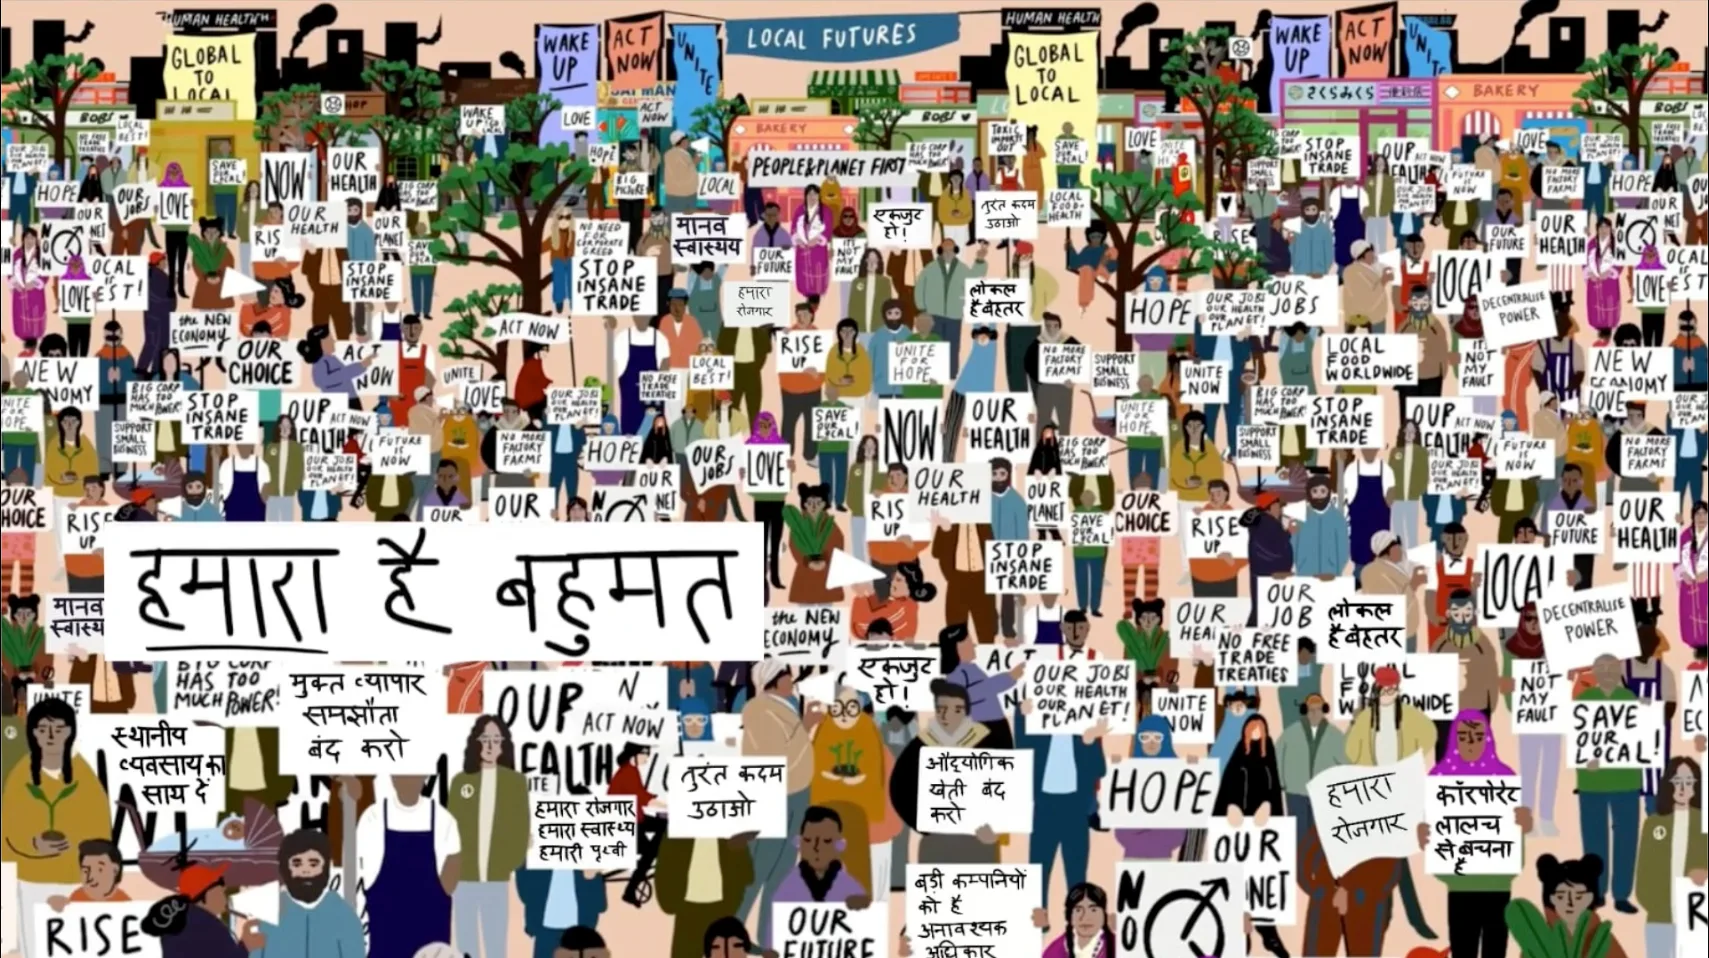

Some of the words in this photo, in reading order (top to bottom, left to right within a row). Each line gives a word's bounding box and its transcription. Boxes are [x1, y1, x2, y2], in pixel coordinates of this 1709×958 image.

[1006, 12, 1053, 25] HUMAN
[1345, 16, 1385, 41] ACT
[544, 32, 589, 53] WAKE
[613, 25, 653, 49] ACT
[748, 28, 806, 50] LOCAL
[823, 23, 915, 49] FUTURES
[1276, 23, 1321, 45] WAKE
[172, 44, 241, 70] GLOBAL
[617, 50, 656, 73] NOW
[1014, 43, 1082, 68] GLOBAL
[1285, 47, 1310, 74] UP
[1349, 41, 1388, 64] NOW
[553, 55, 578, 82] UP
[677, 32, 713, 95] UNITE
[194, 69, 214, 86] TO
[1036, 68, 1056, 84] TO
[1016, 84, 1080, 106] LOCAL
[1473, 84, 1539, 97] BAKERY
[564, 111, 590, 126] LOVE
[1128, 130, 1156, 148] LOVE
[1517, 132, 1546, 149] LOVE
[333, 151, 367, 171] OUR
[870, 157, 906, 175] FIRST
[265, 159, 306, 203] NOW
[331, 174, 377, 194] HEALTH
[699, 177, 734, 196] LOCAL
[375, 216, 400, 230] OUR
[676, 217, 729, 235] मानव
[873, 208, 924, 226] एकजुट
[759, 249, 784, 260] OUR
[579, 258, 635, 279] STOP
[757, 260, 791, 274] FUTURE
[577, 276, 645, 295] INSANE
[1270, 280, 1307, 296] OUR
[1636, 274, 1665, 302] LOVE
[584, 294, 639, 312] TRADE
[1130, 298, 1191, 326] HOPE
[1270, 296, 1319, 316] JOBS
[205, 313, 230, 325] NEW
[172, 327, 231, 352] ECONOMY
[499, 319, 523, 336] ACT
[528, 322, 560, 340] NOW
[238, 340, 282, 361] OUR
[781, 335, 823, 354] RISE
[895, 344, 935, 359] UNITE
[1328, 336, 1385, 354] LOCAL
[792, 356, 806, 368] UP
[1095, 353, 1135, 365] SUPPORT
[1327, 354, 1370, 366] FOOD
[229, 361, 292, 385] CHOICE
[894, 366, 932, 383] HOPE
[1096, 365, 1128, 376] SMALL
[1185, 365, 1222, 379] UNITE
[1326, 365, 1413, 381] WORLDWIDE
[1189, 381, 1220, 395] NOW
[188, 393, 238, 411] STOP
[972, 398, 1017, 423] OUR
[186, 408, 248, 426] INSANE
[815, 409, 847, 425] SAVE
[192, 423, 242, 441] TRADE
[884, 407, 938, 465] NOW
[971, 427, 1030, 453] HEALTH
[588, 441, 638, 464] HOPE
[692, 445, 725, 466] OUR
[748, 450, 785, 487] LOVE
[1555, 512, 1587, 527] OUR
[1620, 497, 1664, 522] OUR
[1071, 514, 1102, 528] SAVE
[1192, 516, 1239, 537] RISE
[1553, 528, 1597, 545] FUTURE
[1618, 526, 1677, 552] HEALTH
[129, 548, 340, 642] हमारा
[377, 527, 452, 634] है
[496, 550, 739, 657] बहुमत
[805, 608, 840, 625] NEW
[1564, 618, 1618, 643] POWER
[1218, 632, 1241, 649] NO
[1252, 632, 1290, 652] FREE
[1220, 649, 1274, 665] TRADE
[857, 657, 936, 683] एकजुट
[1033, 664, 1077, 684] OUR
[1086, 664, 1130, 684] JOBS
[1218, 666, 1288, 683] TREATIES
[176, 671, 214, 691] HAS
[228, 671, 260, 688] TOO
[289, 674, 345, 699] मुक्त
[1521, 674, 1562, 693] NOT
[1075, 685, 1127, 699] HEALTH
[174, 692, 223, 709] MUCH
[225, 688, 280, 717] POWER!
[1158, 694, 1207, 712] UNITE
[1517, 705, 1557, 723] FAULT
[1573, 704, 1638, 731] SAVE
[111, 719, 188, 748] स्थानीय
[583, 712, 615, 735] ACT
[622, 715, 664, 739] NOW
[308, 739, 343, 763] बंद
[361, 729, 410, 761] करो
[1575, 729, 1660, 765] LOCAL!
[1576, 730, 1618, 749] OUR
[738, 764, 785, 783] कदम
[982, 778, 1005, 800] बंद
[1109, 769, 1212, 814] HOPE
[930, 801, 966, 824] करो
[1215, 829, 1281, 862] OUR
[788, 907, 852, 936] OUR
[47, 914, 142, 957] RISE
